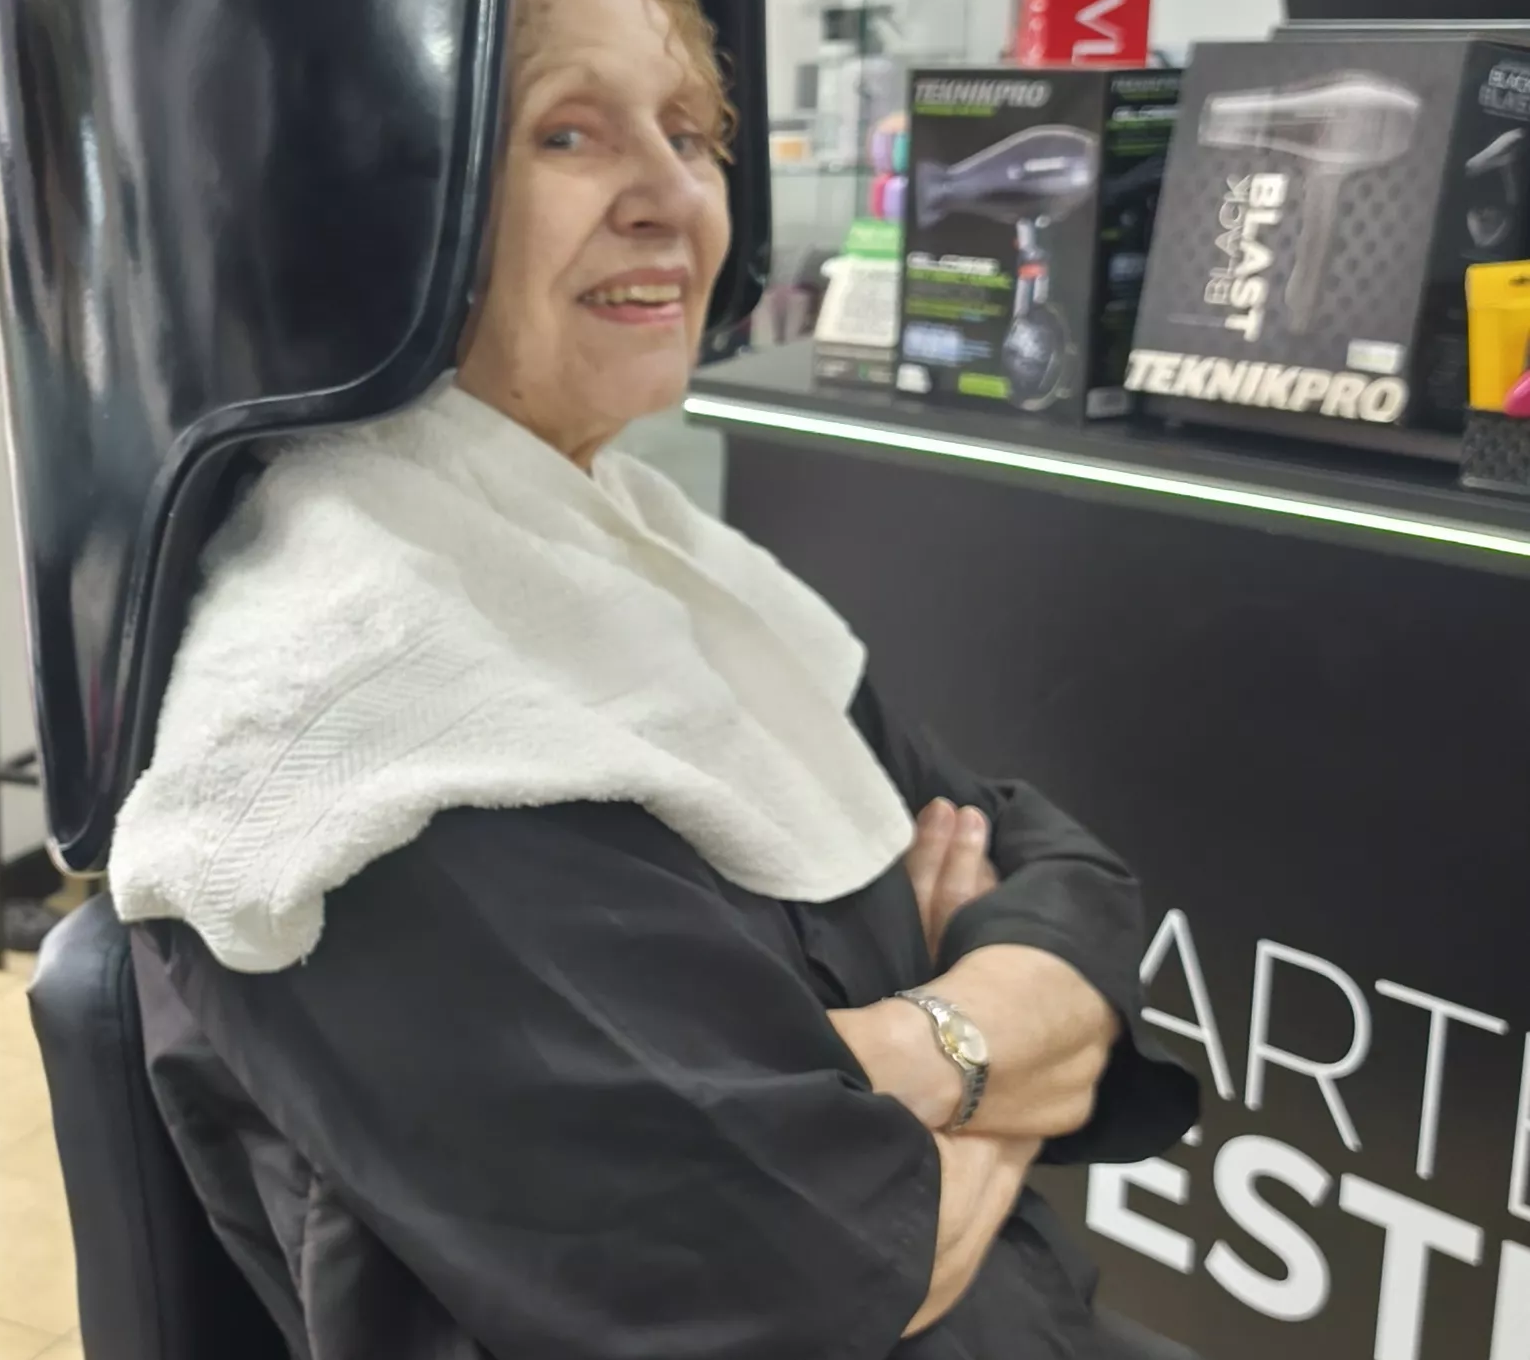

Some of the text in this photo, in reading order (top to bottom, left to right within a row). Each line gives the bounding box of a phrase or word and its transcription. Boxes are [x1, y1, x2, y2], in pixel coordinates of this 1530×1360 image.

[1203, 174, 1252, 305] BLACK
[1224, 172, 1289, 343] BLAST
[1123, 348, 1410, 424] TEKNIKPRO
